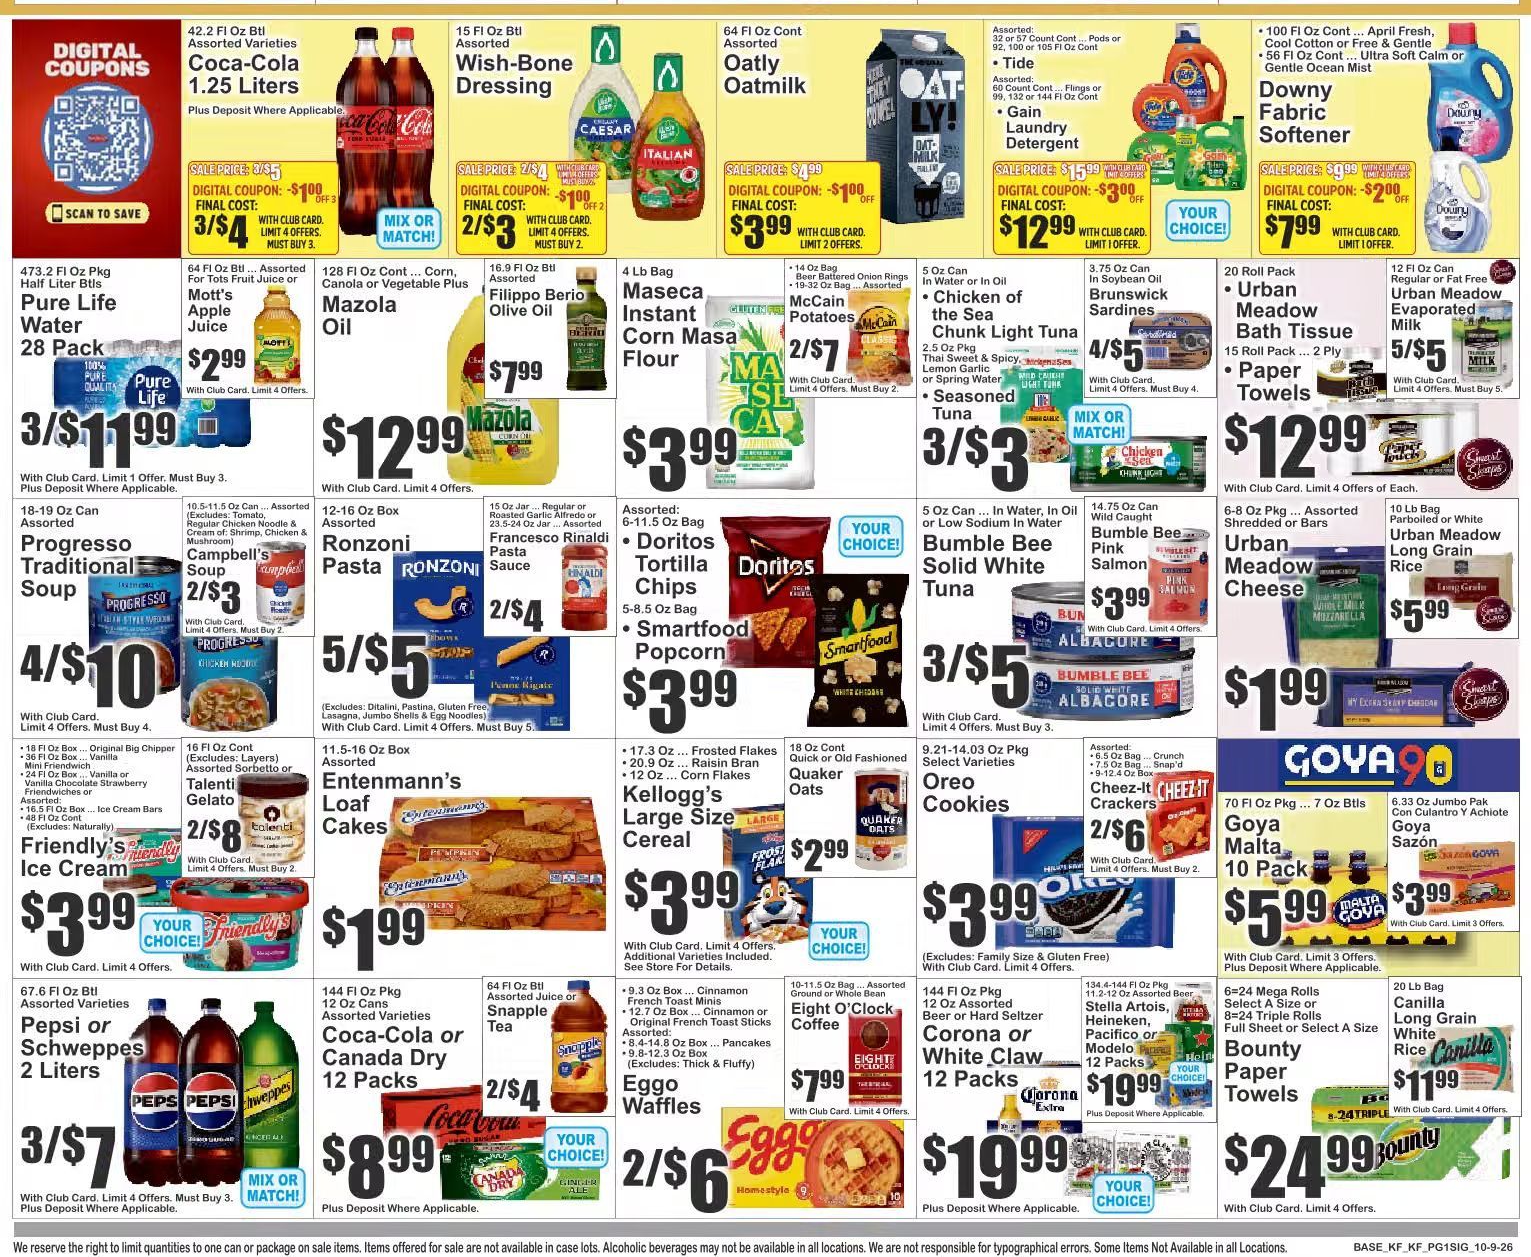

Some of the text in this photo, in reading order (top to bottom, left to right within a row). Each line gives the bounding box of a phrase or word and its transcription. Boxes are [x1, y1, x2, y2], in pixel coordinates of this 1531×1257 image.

[54, 42, 142, 59] DIGITAL
[45, 60, 150, 78] COUPONS
[189, 54, 299, 71] Coca-Cola
[724, 75, 806, 94] Oatmilk
[1260, 81, 1332, 104] Downy
[188, 104, 343, 118] Plus Deposit Where Applicable.
[1006, 135, 1079, 152] Detergent
[643, 149, 693, 160] ITALIAN
[818, 273, 855, 282] Battered
[884, 273, 909, 282] Rings
[623, 282, 703, 299] Maseca
[1090, 288, 1168, 300] Brunswick
[22, 293, 116, 311] Pure Life
[323, 295, 396, 313] Mazola
[1237, 323, 1353, 339] Bath Tissue
[1390, 513, 1483, 524] Parboiled or White
[22, 534, 132, 556] Progresso
[490, 532, 609, 545] Francesco Rinaldi
[402, 559, 479, 578] RONZONI
[635, 555, 708, 572] Tortilla
[923, 557, 1045, 574] Solid White
[1057, 693, 1147, 708] ALBACORE
[1285, 744, 1396, 777] GOYA
[323, 772, 461, 789] Entenmann's
[789, 767, 843, 784] Quaker
[923, 772, 975, 790] Oreo
[1392, 807, 1509, 817] Con Culantro Y Achiote
[628, 996, 722, 1006] French Toast Minis
[20, 1038, 145, 1060] Schweppes
[1225, 1039, 1301, 1064] Bounty
[322, 1048, 447, 1070] Canada Dry
[13, 1241, 191, 1256] We reserve the right to limit quantities
[1354, 1242, 1513, 1253] BASE_KF_KF_PG1SIG_10-9-26
